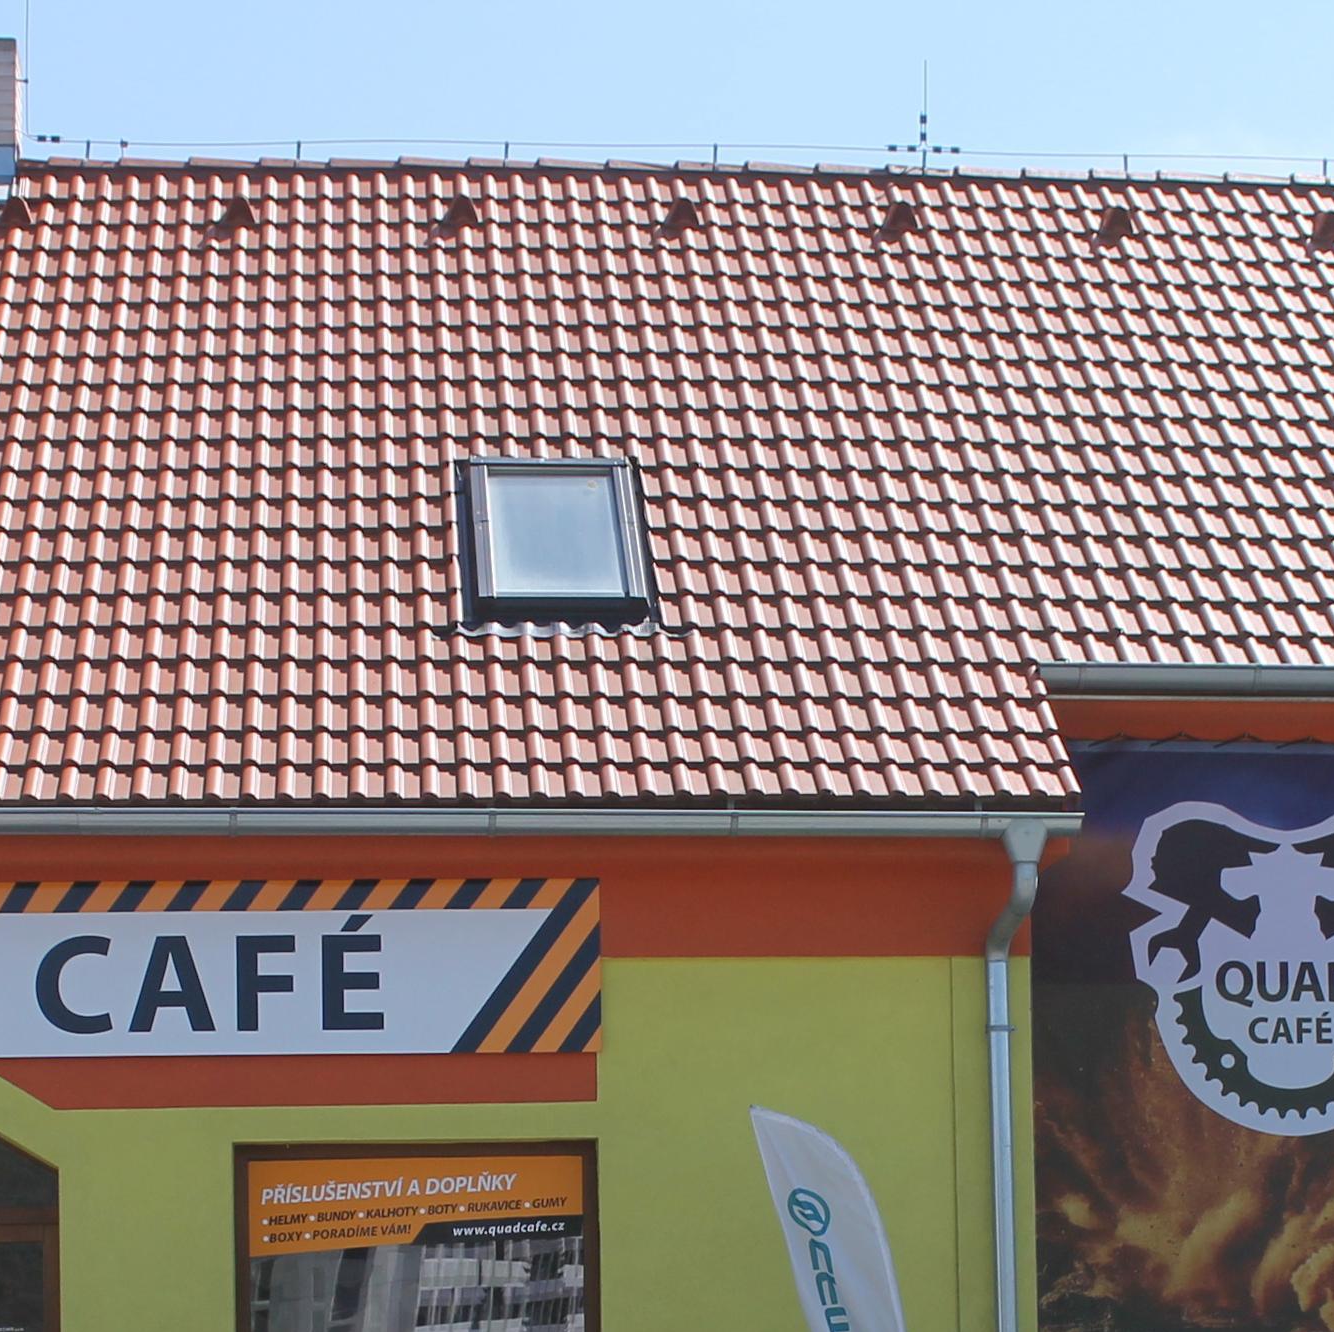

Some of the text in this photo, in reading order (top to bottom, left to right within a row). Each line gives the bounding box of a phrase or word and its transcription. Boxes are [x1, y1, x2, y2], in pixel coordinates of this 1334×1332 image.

[34, 914, 385, 1035] CAFÉ
[1247, 1011, 1334, 1045] CAFÉ
[260, 1171, 517, 1205] PŘÍSLUŠENSTVÍ A DOPLŇKY
[268, 1196, 568, 1226] HELMY BUNDY KALHOTY BOTY RUKAVICE GUMY
[269, 1223, 412, 1244] BOXY PORADÍME VÁM!
[452, 1220, 565, 1238] www.quadcafe.cz
